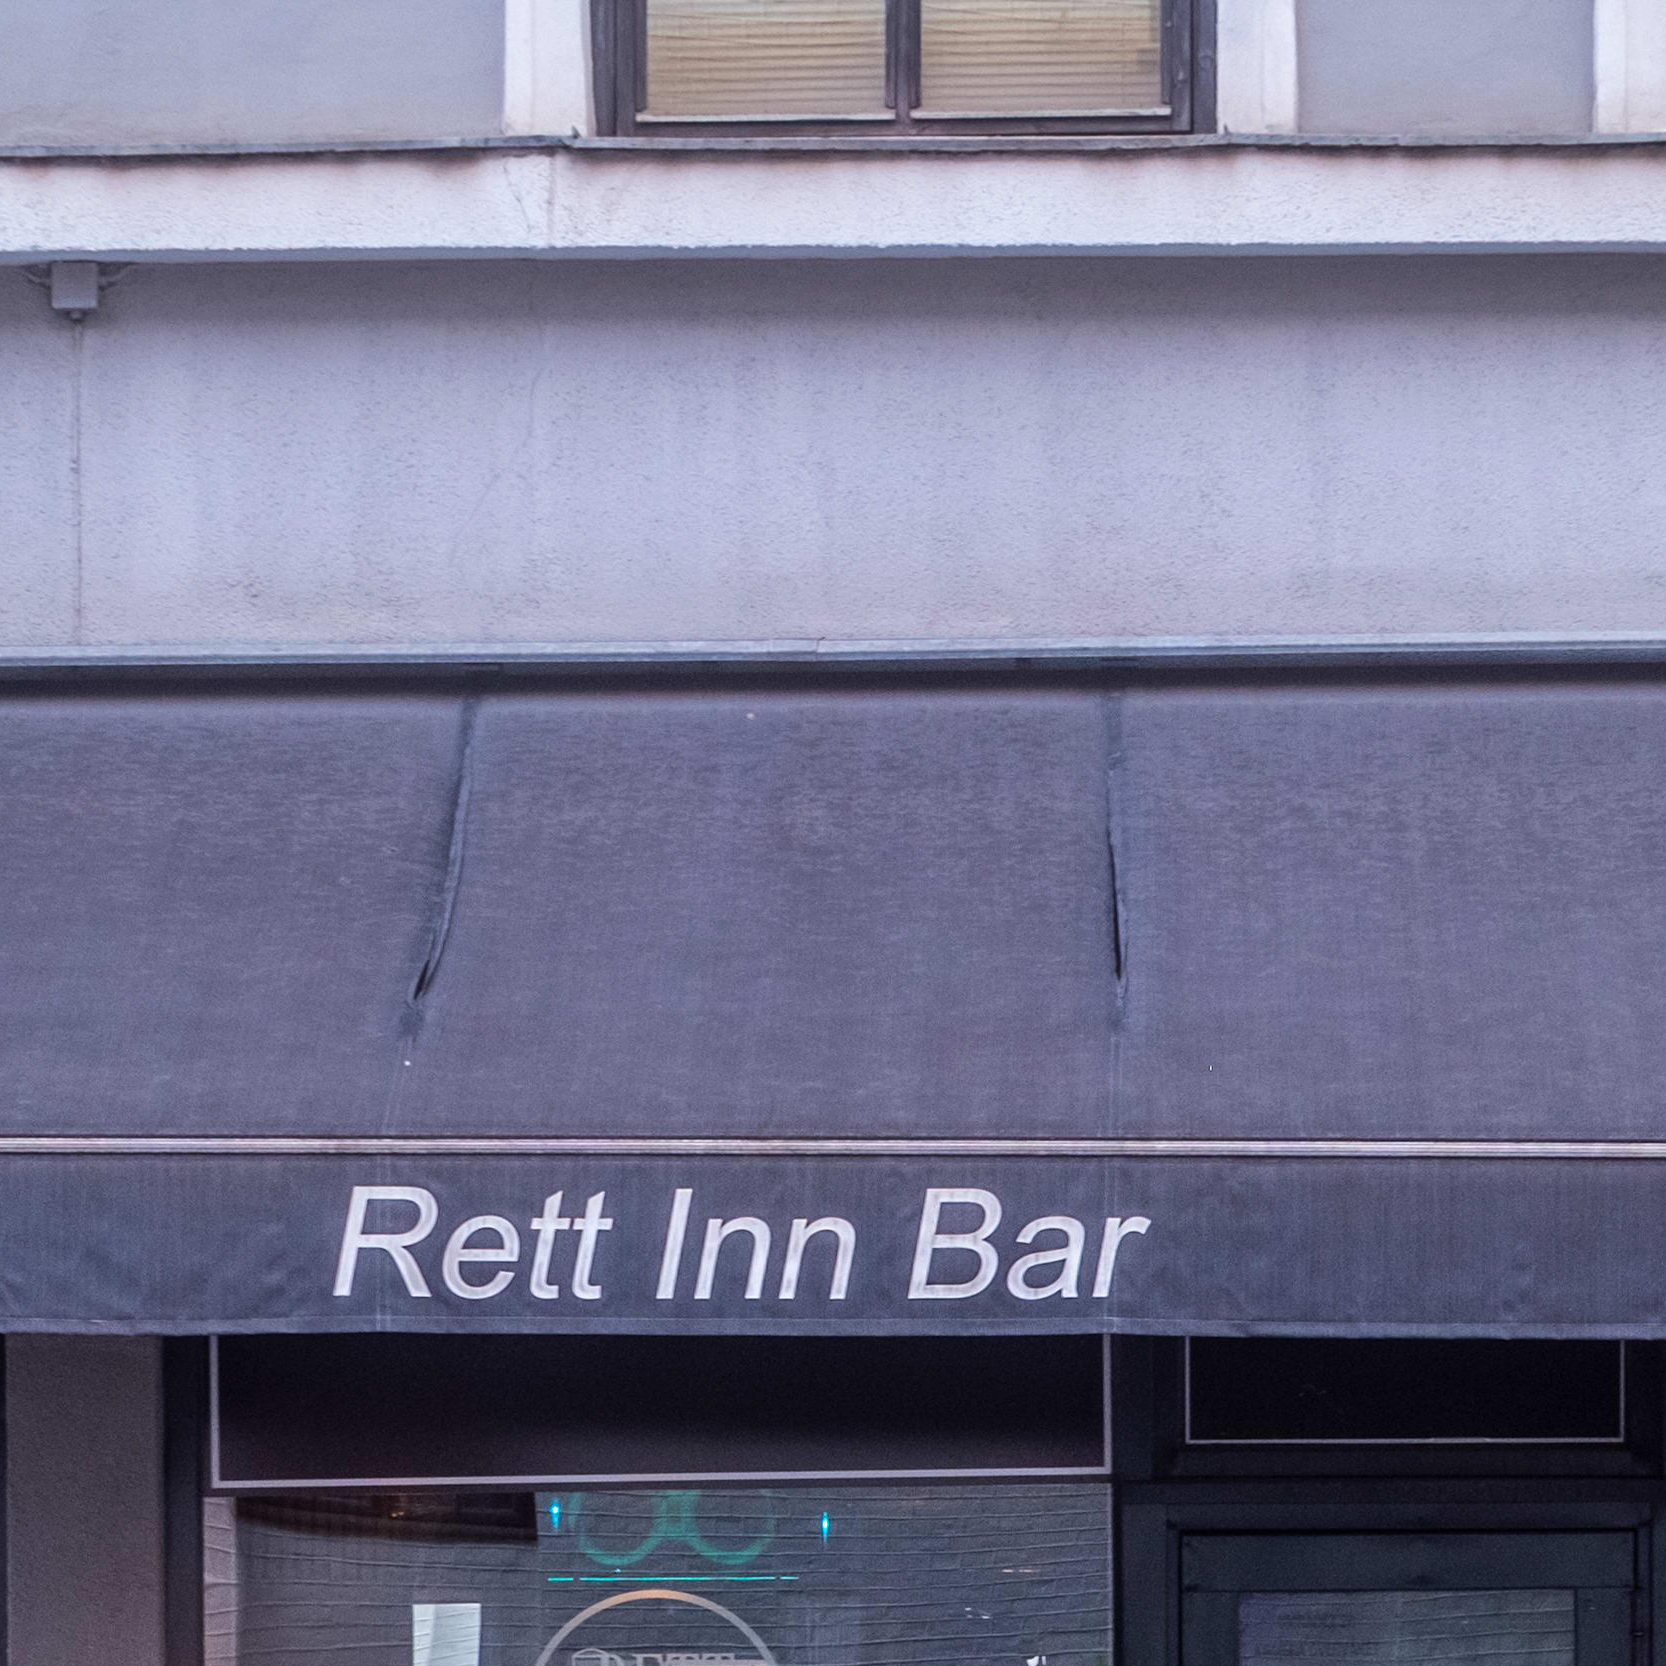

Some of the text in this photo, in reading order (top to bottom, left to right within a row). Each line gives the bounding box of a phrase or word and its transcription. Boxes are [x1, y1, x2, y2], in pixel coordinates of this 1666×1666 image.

[333, 1186, 1152, 1301] Rett Inn Bar
